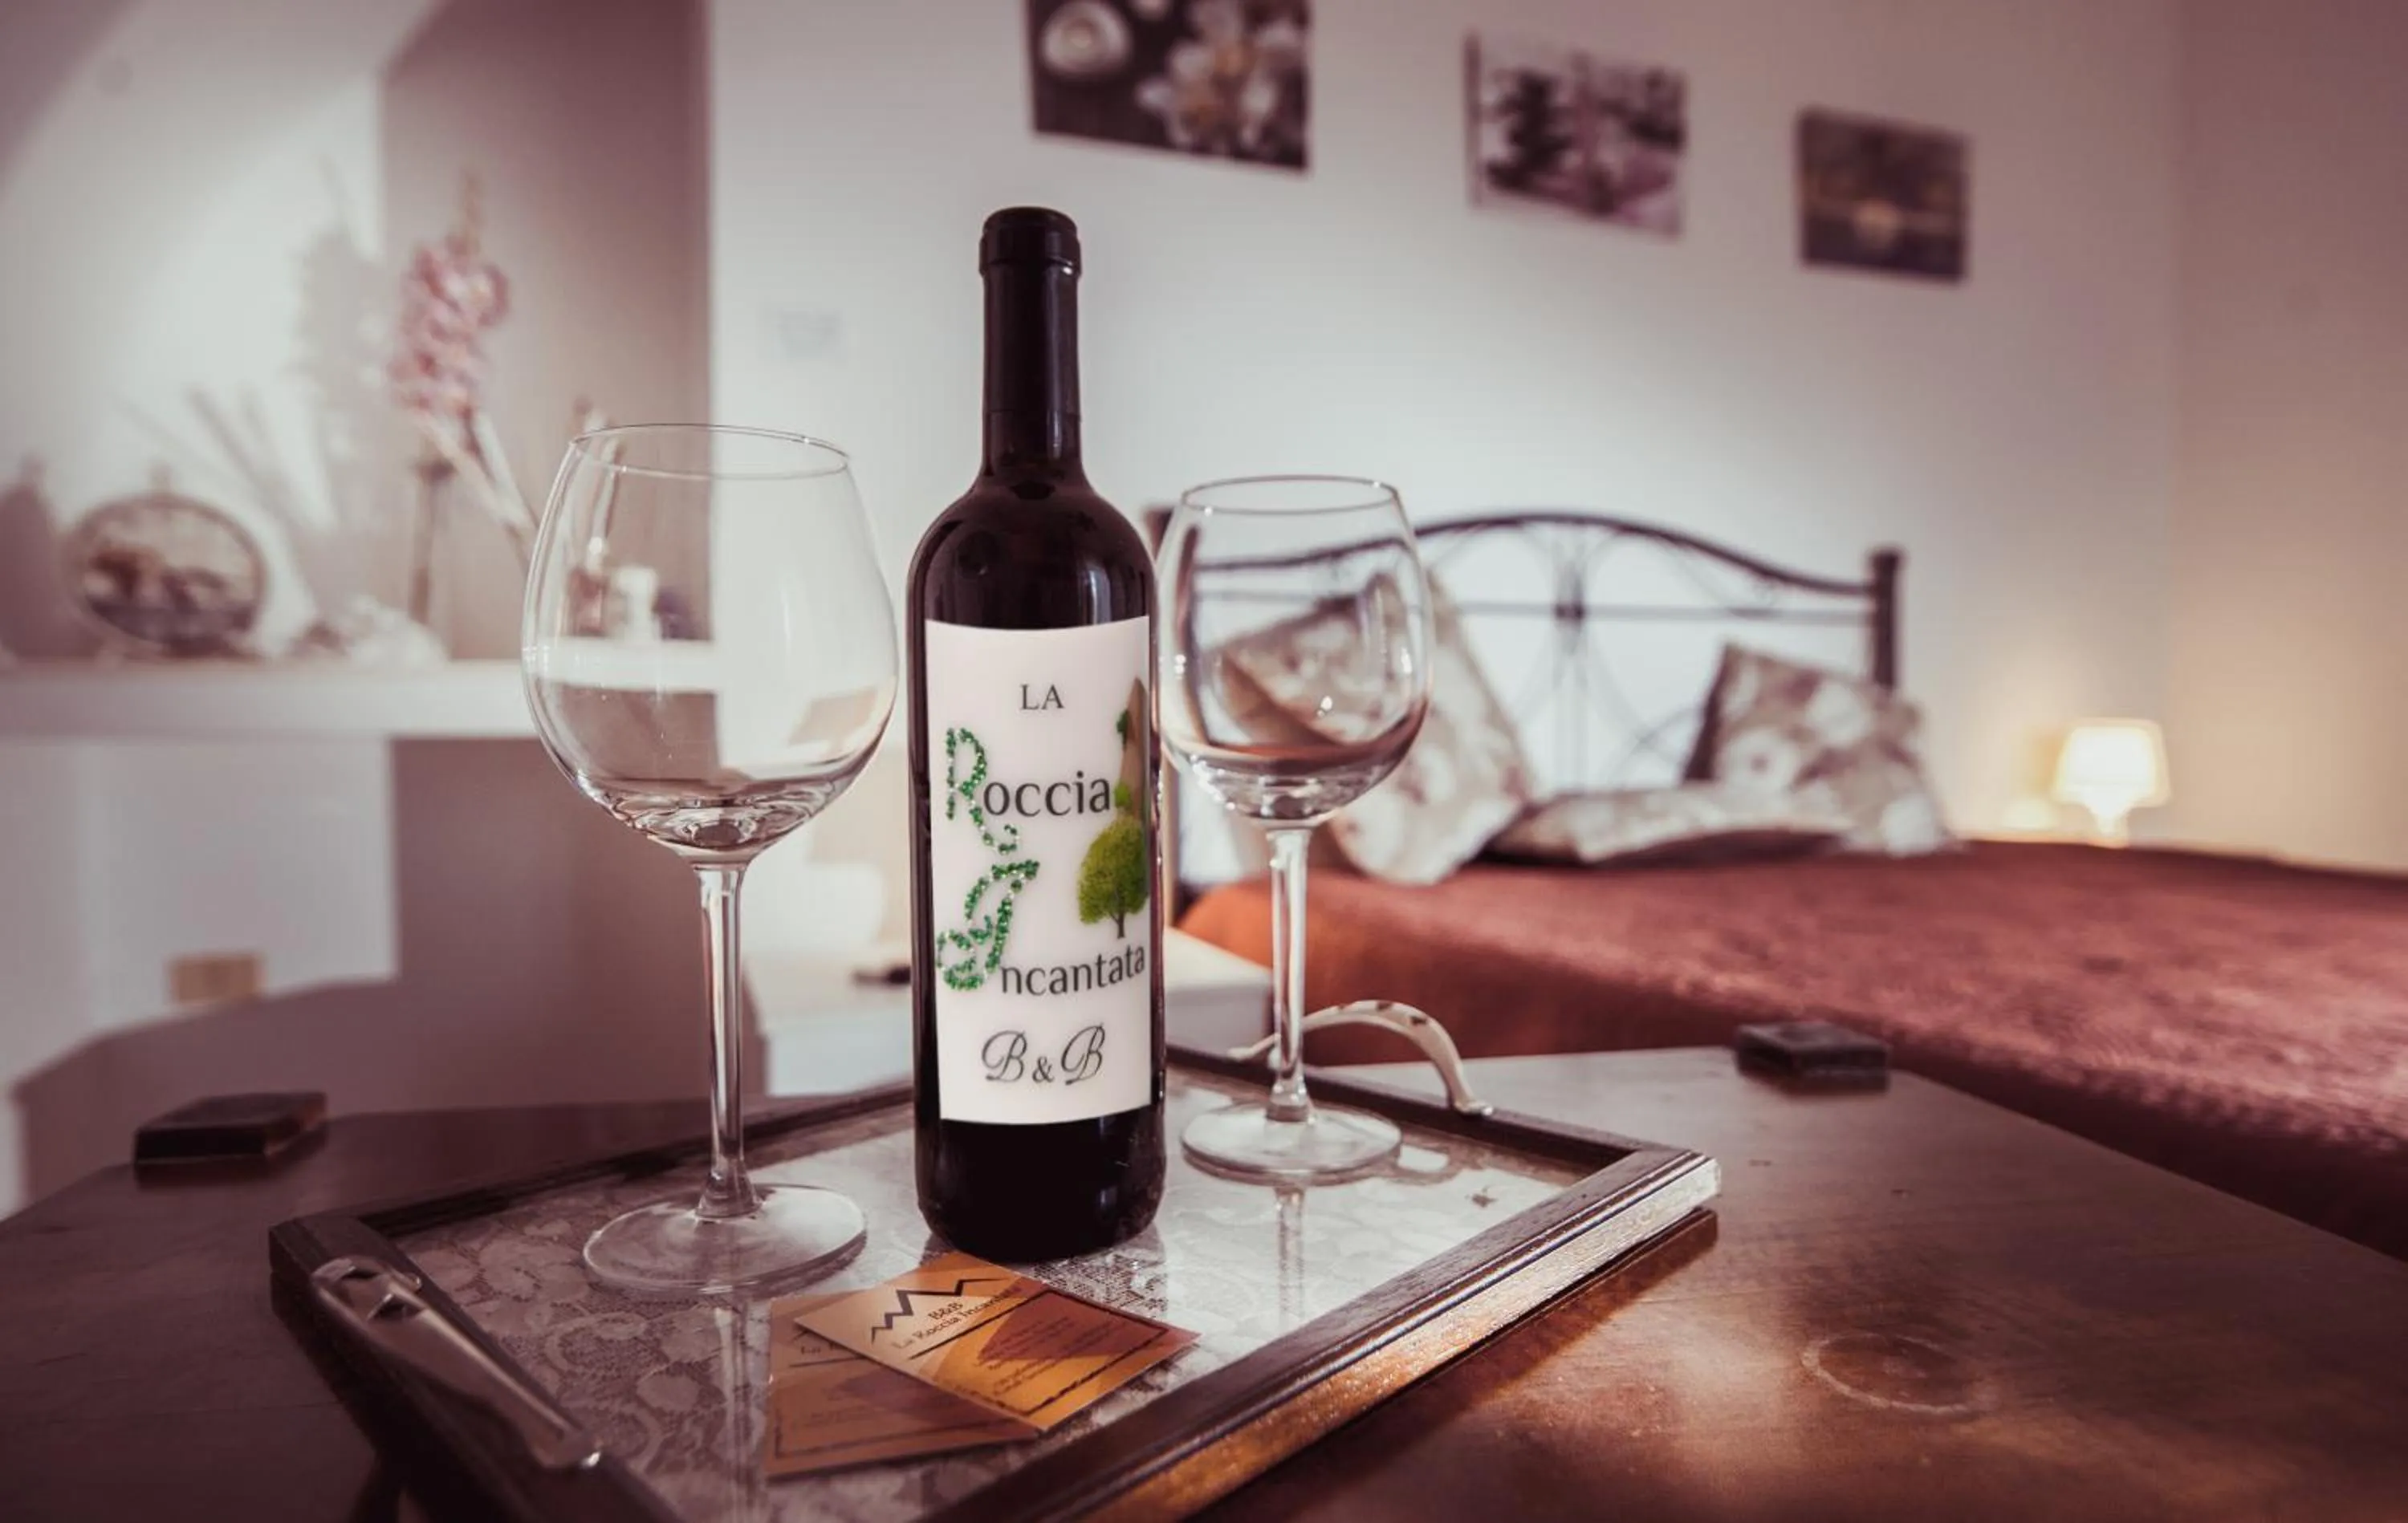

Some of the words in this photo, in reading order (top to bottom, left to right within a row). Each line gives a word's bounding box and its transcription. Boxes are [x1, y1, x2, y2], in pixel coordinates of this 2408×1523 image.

[1019, 684, 1064, 710] LA
[946, 727, 1111, 855] Roccia
[937, 859, 1145, 997] Incantata
